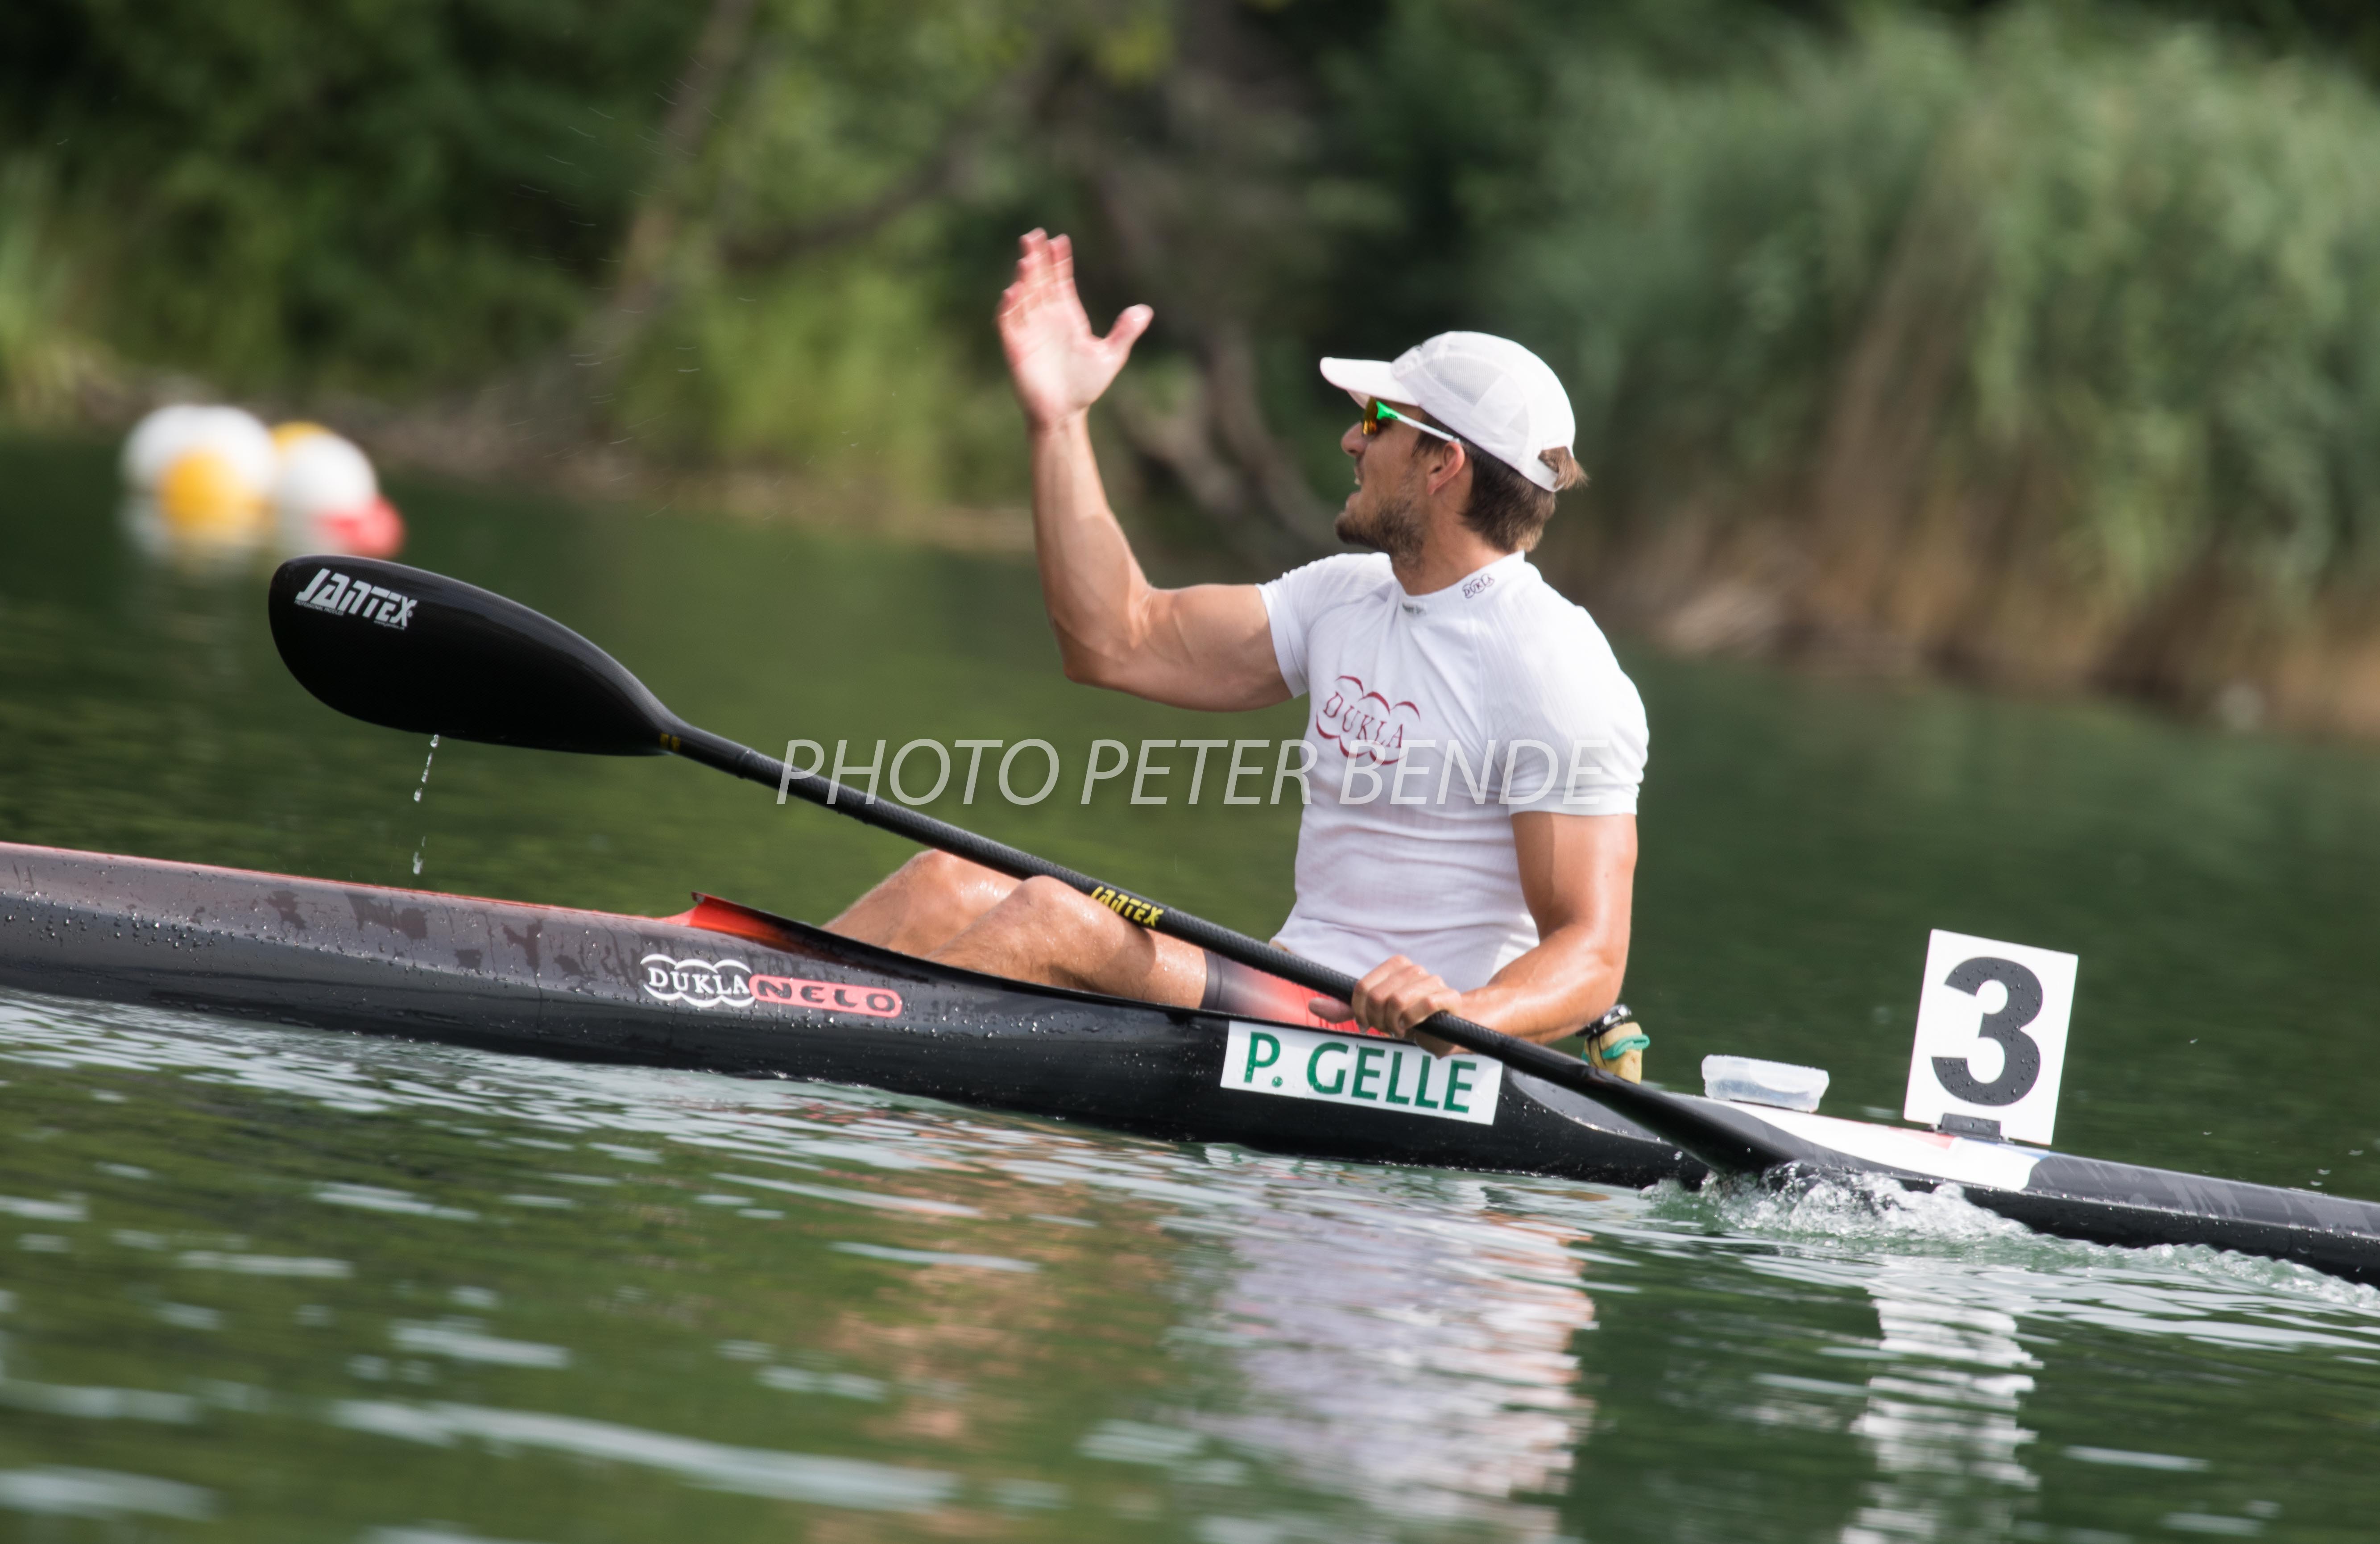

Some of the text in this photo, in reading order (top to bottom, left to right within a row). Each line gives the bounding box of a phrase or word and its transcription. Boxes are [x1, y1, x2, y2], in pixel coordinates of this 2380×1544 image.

[295, 568, 418, 627] JANTEX
[1464, 576, 1494, 596] DUKLA
[1323, 691, 1403, 749] DUKLA
[648, 966, 750, 995] DUKLA
[758, 981, 896, 1012] NELO
[1931, 956, 2043, 1106] 3
[1243, 1031, 1478, 1114] P. GELLE
